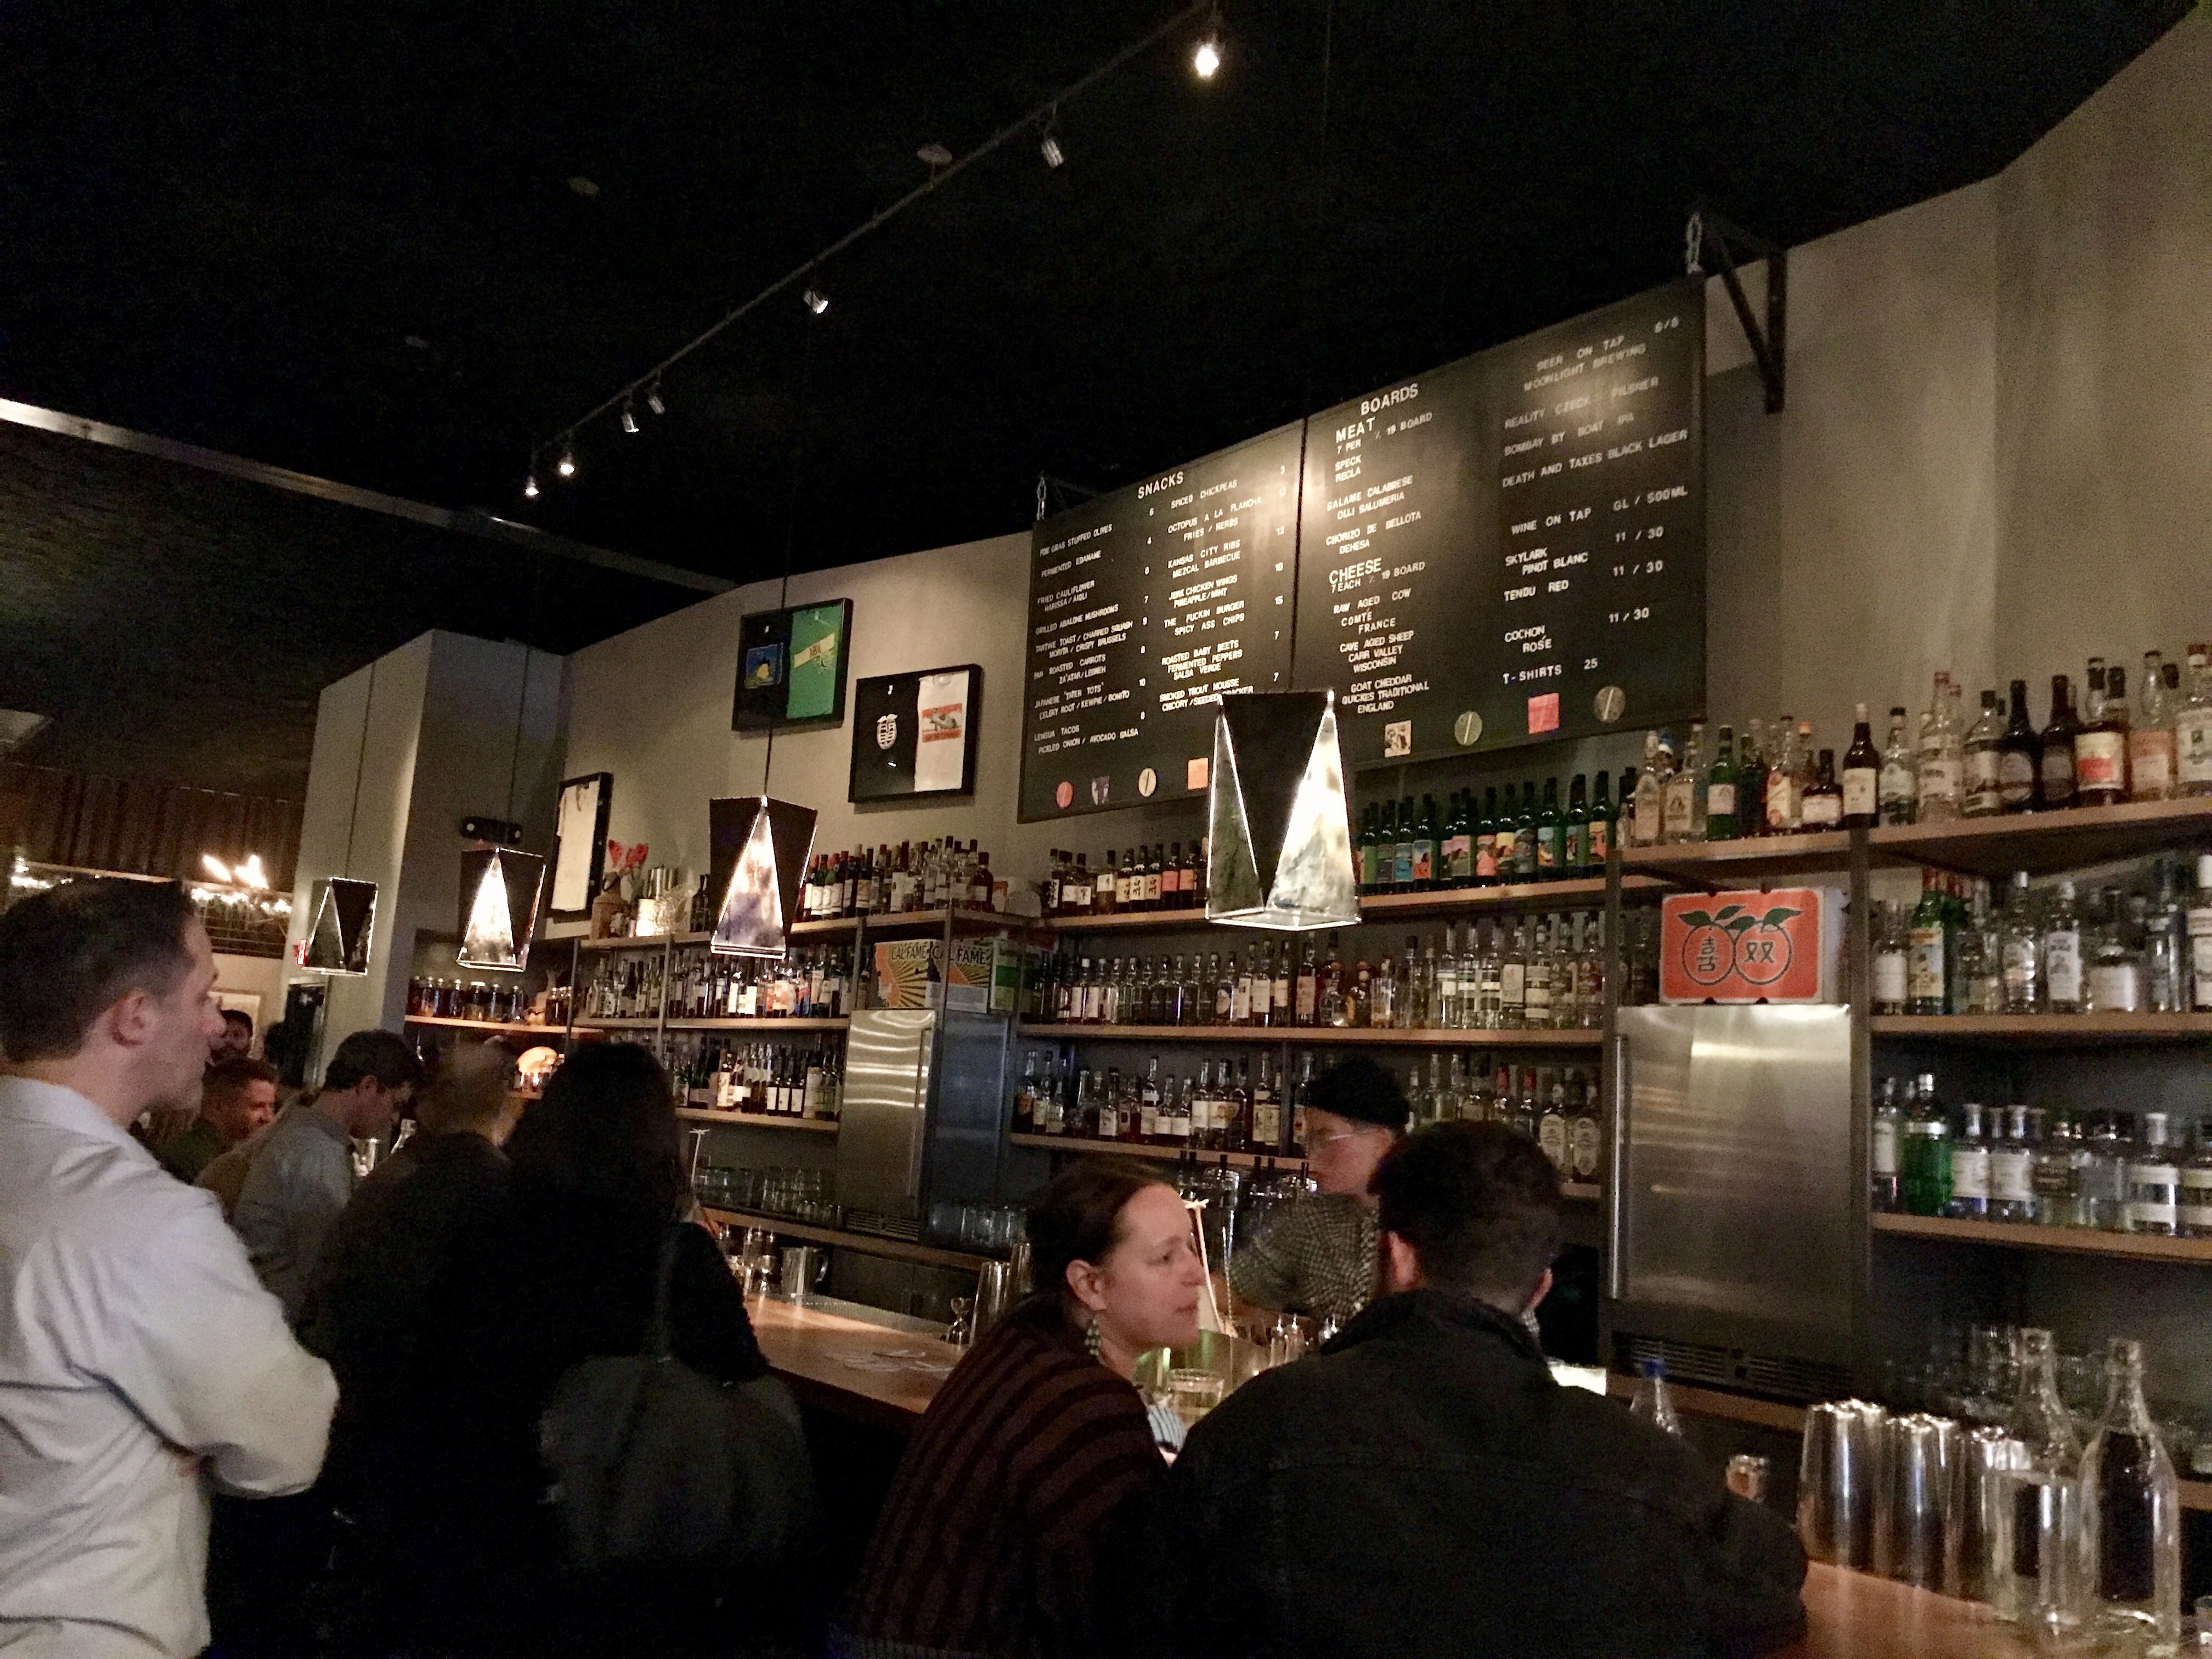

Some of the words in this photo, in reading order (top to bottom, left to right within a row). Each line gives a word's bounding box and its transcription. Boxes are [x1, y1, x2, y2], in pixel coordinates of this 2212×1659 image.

[1537, 356, 1563, 371] BEER
[1577, 346, 1592, 358] ON
[1604, 335, 1624, 351] TAP
[1524, 363, 1585, 391] MOONLIGHT
[1361, 383, 1419, 415] BOARDS
[1336, 417, 1375, 443] MEAT
[1505, 408, 1545, 429] REALITY
[1338, 445, 1342, 454] 7
[1346, 439, 1361, 452] PER
[1387, 424, 1396, 435] 19
[1400, 412, 1432, 431] BOARD
[1504, 438, 1544, 456] BOMBAY
[1551, 431, 1565, 444] BY
[1577, 421, 1604, 437] BOAT
[1618, 413, 1634, 425] IPA
[1335, 454, 1361, 471] SPECK
[1503, 470, 1535, 488] DEATH
[1541, 463, 1562, 477] AND
[1569, 453, 1602, 470] TAXES
[1607, 441, 1643, 459] BLACK
[1649, 429, 1688, 449] LAGER
[1138, 471, 1184, 499] SNACKS
[1335, 467, 1361, 483] RECLA
[1171, 494, 1193, 509] SPICED
[1200, 479, 1238, 499] CHICKPEAS
[1327, 492, 1362, 511] SALAME
[1367, 475, 1413, 498] CALABRESE
[1337, 507, 1355, 520] OLLI
[1359, 491, 1404, 514] SALUMERIA
[1613, 499, 1629, 511] GL
[1646, 486, 1688, 504] 500ML
[1167, 517, 1198, 533] OCTOPUS
[1204, 514, 1209, 522] A
[1214, 509, 1223, 518] LA
[1231, 496, 1261, 512] PLANCHA
[1279, 487, 1286, 497] 12
[1511, 520, 1537, 534] WINE
[1545, 515, 1561, 527] ON
[1569, 508, 1592, 522] TAP
[1051, 540, 1065, 553] GRAS
[1068, 532, 1091, 547] STUFFED
[1093, 523, 1112, 538] OLIVES
[1183, 528, 1204, 541] FRIES
[1216, 517, 1238, 532] HERBS
[1326, 528, 1361, 546] CHORIZO
[1367, 523, 1377, 534] DE
[1386, 511, 1421, 531] BELLOTA
[1615, 532, 1626, 542] 11
[1647, 526, 1663, 540] 30
[1167, 554, 1193, 568] KANSAS
[1200, 546, 1218, 558] CITY
[1223, 539, 1240, 551] RIBS
[1277, 526, 1285, 535] 12
[1339, 539, 1370, 555] DEHESA
[1505, 548, 1548, 567] SKYLARK
[1041, 561, 1071, 577] FERMENTED
[1076, 550, 1101, 565] EDAMAME
[1172, 563, 1199, 578] MEZCAL
[1204, 551, 1240, 568] BARBECUE
[1329, 557, 1382, 584] CHEESE
[1522, 560, 1548, 575] PINOT
[1554, 552, 1589, 569] BLANC
[1613, 566, 1624, 577] 11
[1646, 560, 1663, 574] 30
[1169, 589, 1184, 600] JERK
[1186, 580, 1214, 595] CHICKEN
[1216, 574, 1238, 587] WINGS
[1275, 562, 1283, 572] 10
[1338, 578, 1361, 592] EACH
[1382, 570, 1390, 580] 19
[1394, 561, 1425, 577] BOARD
[1037, 594, 1053, 604] FRIED
[1056, 580, 1095, 599] CAULIFLOWER
[1334, 602, 1350, 614] RAW
[1357, 596, 1380, 609] AGED
[1392, 588, 1411, 601] COW
[1504, 586, 1536, 602] TENDU
[1548, 579, 1569, 593] RED
[1036, 622, 1057, 635] GRILLED
[1059, 614, 1083, 628] ABALONE
[1085, 603, 1119, 621] MUSHROOMS
[1144, 595, 1149, 604] 7
[1164, 618, 1177, 628] THE
[1186, 609, 1210, 623] FUCKIN
[1216, 600, 1244, 614] BURGER
[1275, 596, 1283, 605] 15
[1175, 624, 1194, 636] SPICY
[1201, 619, 1215, 630] ASS
[1223, 613, 1245, 626] CHIPS
[1609, 613, 1619, 623] 11
[1633, 607, 1649, 620] 30
[1036, 641, 1056, 653] TARTINE
[1059, 635, 1076, 646] TOAST
[1083, 627, 1109, 640] CHARRED
[1111, 621, 1133, 633] SQUASH
[1358, 618, 1396, 635] FRANCE
[1505, 625, 1545, 642] COCHON
[1049, 647, 1068, 658] MORITA
[1076, 642, 1094, 652] CRISPY
[1098, 633, 1126, 647] BRUSSELS
[1161, 652, 1190, 665] ROASTED
[1193, 646, 1211, 657] BABY
[1217, 640, 1239, 652] BEETS
[1274, 631, 1279, 640] 7
[1340, 641, 1359, 652] CAVE
[1364, 637, 1385, 648] AGED
[1389, 630, 1414, 643] SHEEP
[1034, 671, 1043, 679] PAN
[1049, 662, 1073, 675] ROASTED
[1080, 654, 1106, 667] CARROTS
[1167, 658, 1207, 673] FERMENTED
[1212, 650, 1243, 663] PEPPERS
[1348, 650, 1370, 663] CARR
[1374, 645, 1403, 657] VALLEY
[1353, 656, 1396, 674] WISCONSIN
[1173, 670, 1194, 680] SALSA
[1200, 663, 1222, 674] VERDE
[1351, 681, 1372, 693] GOAT
[1375, 674, 1412, 689] CHEDDAR
[1503, 664, 1562, 685] T-SHIRTS
[1584, 658, 1598, 670] 25
[1035, 695, 1060, 708] JAPANESE
[1139, 678, 1146, 686] 10
[1159, 690, 1185, 702] SMOKED
[1188, 685, 1209, 696] TROUT
[1213, 678, 1239, 691] MOUSSE
[1274, 673, 1279, 681] 7
[1342, 692, 1374, 705] QUICKES
[1378, 681, 1429, 701] TRADITIONAL
[1060, 703, 1075, 713] ROOT
[1081, 697, 1102, 708] KEWPIE
[1108, 690, 1130, 702] BONITO
[1357, 701, 1394, 714] ENGLAND
[1034, 730, 1055, 741] LENGUA
[1061, 725, 1079, 736] TACOS
[1039, 743, 1060, 754] PICKLED
[1063, 737, 1080, 748] ONION
[1090, 732, 1116, 743] AVOCADO
[1120, 728, 1138, 739] SALSA
[891, 947, 905, 960] CAL
[906, 946, 926, 959] FAME
[957, 946, 986, 964] FAME
